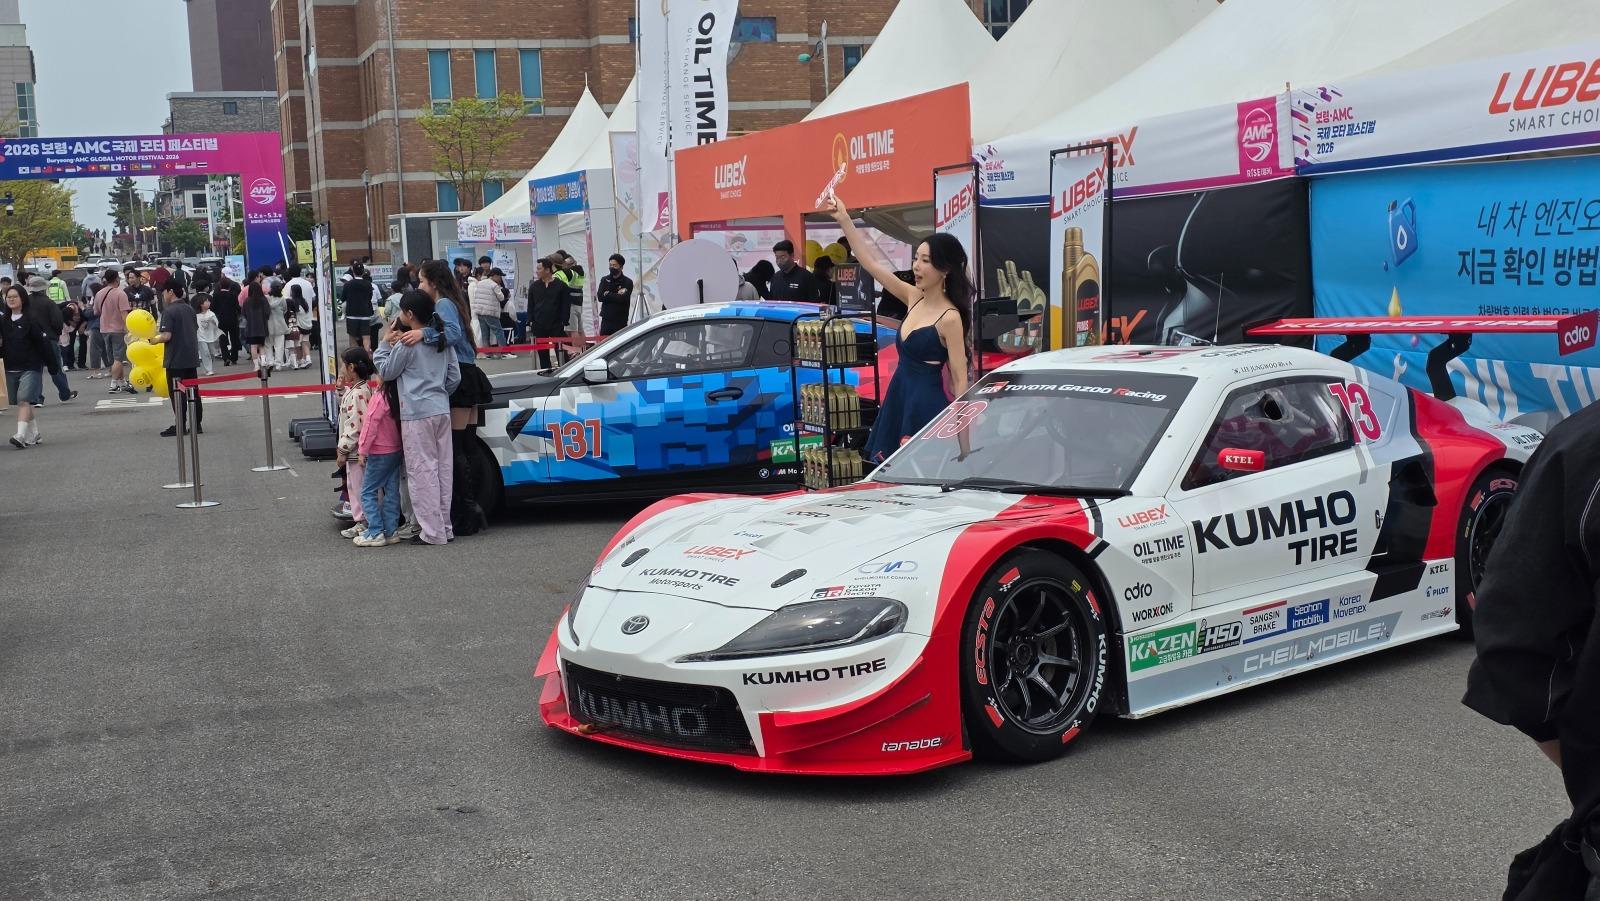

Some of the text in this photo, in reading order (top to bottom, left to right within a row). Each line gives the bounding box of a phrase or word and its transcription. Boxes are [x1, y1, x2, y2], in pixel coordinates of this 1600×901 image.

[693, 12, 718, 145] OIL TIME
[683, 94, 693, 137] SERVICE
[1316, 107, 1354, 125] 보령·AMC
[1509, 113, 1555, 133] SMART
[1242, 122, 1273, 143] AMF
[1316, 119, 1377, 141] 국제 모터 페스티벌
[3, 143, 40, 156] 2026
[112, 139, 139, 153] 국제
[140, 139, 166, 152] 모터
[167, 137, 218, 151] 페스티벌
[850, 128, 894, 160] OIL TIME
[1316, 142, 1335, 155] 2026
[715, 154, 748, 189] LUBEX
[250, 186, 277, 195] AMF
[1051, 166, 1106, 220] LUBEX
[1063, 208, 1082, 225] SMART
[1477, 200, 1501, 237] 내
[1503, 200, 1527, 237] 차
[1457, 245, 1600, 287] 지금 확인 방법
[1564, 324, 1590, 347] adro
[1005, 383, 1055, 391] TOYOTA
[1058, 384, 1112, 394] GAZOO
[1113, 387, 1167, 401] Racing
[922, 400, 988, 440] 13
[1328, 382, 1382, 445] 13
[1225, 455, 1254, 465] KTEL
[1117, 504, 1170, 528] LUBEX
[1191, 489, 1357, 553] KUMHO
[683, 545, 757, 560] LUBEX
[1133, 535, 1185, 557] OIL TIME
[1288, 528, 1358, 566] TIRE
[639, 568, 740, 587] KUMHO TIRE
[1429, 564, 1450, 575] KTEL
[649, 578, 703, 591] Motorsports
[1124, 581, 1153, 601] adro
[1432, 587, 1450, 597] PILOT
[1294, 602, 1323, 616] Seohan
[1339, 594, 1362, 607] Korea
[1250, 610, 1280, 625] SANGSIN
[1292, 613, 1324, 629] Innobility
[1333, 604, 1367, 620] Movenex
[1204, 622, 1242, 646] HSD
[1253, 622, 1277, 634] BRAKE
[975, 596, 996, 685] ECSTA
[1131, 629, 1196, 663] KAZEN
[1243, 622, 1386, 674] CHEILMOBILE
[742, 657, 887, 686] KUMHO TIRE
[1086, 633, 1107, 713] KUMHO
[577, 683, 710, 736] KUMHO
[881, 736, 943, 752] tanabe
